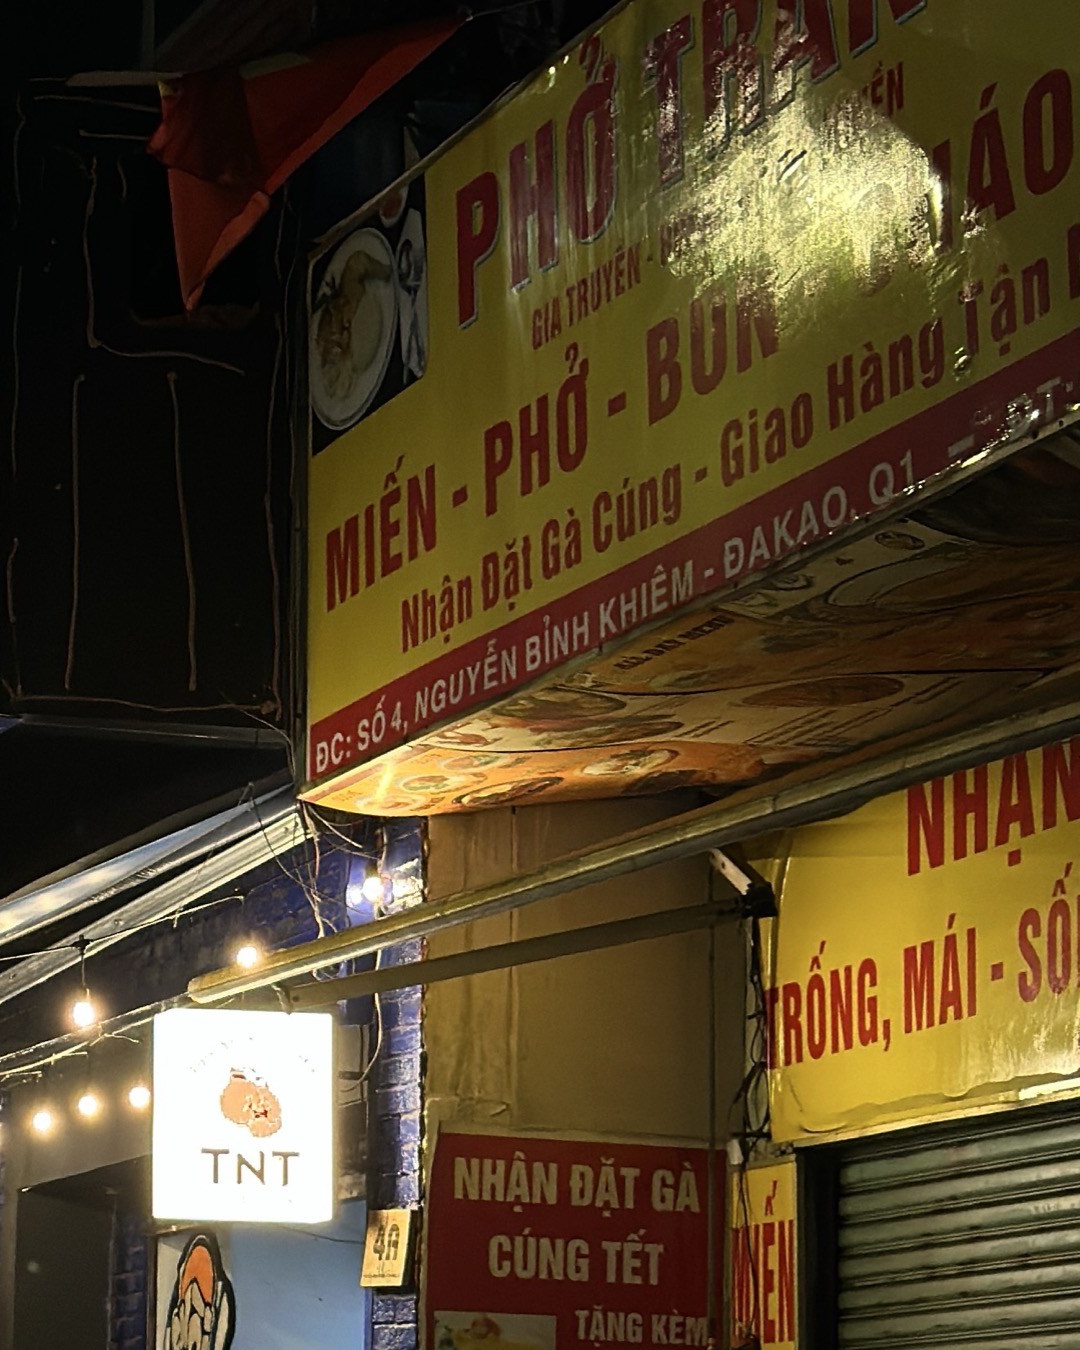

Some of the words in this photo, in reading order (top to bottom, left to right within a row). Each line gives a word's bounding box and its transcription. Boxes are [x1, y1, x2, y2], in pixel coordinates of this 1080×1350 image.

[455, 36, 618, 330] PHỞ
[532, 297, 562, 350] GIA
[326, 454, 437, 612] MIẾN
[484, 343, 589, 518] PHỞ
[401, 574, 472, 653] Nhận
[481, 535, 533, 612] Đặt
[541, 508, 581, 580] Gà
[591, 463, 681, 553] Cúng
[721, 392, 814, 487] Giao
[827, 318, 944, 430] Hàng
[958, 258, 1051, 357] Tận
[315, 731, 352, 773] ĐC:
[357, 695, 388, 752] SỐ
[414, 638, 518, 723] NGUYỄN
[525, 614, 589, 672] BỈNH
[599, 563, 694, 637] KHIÊM
[869, 449, 915, 505] Q1
[904, 913, 977, 1034] MÁI
[1018, 862, 1080, 1003] SỐ
[201, 1147, 300, 1187] TNT
[454, 1150, 558, 1213] NHẬN
[569, 1156, 640, 1218] ĐẶT
[651, 1161, 701, 1214] GÀ
[373, 1224, 400, 1260] 4A
[488, 1227, 590, 1282] CÚNG
[601, 1229, 664, 1286] TẾT
[574, 1305, 644, 1347] TẶNG
[651, 1308, 708, 1346] KÈM
